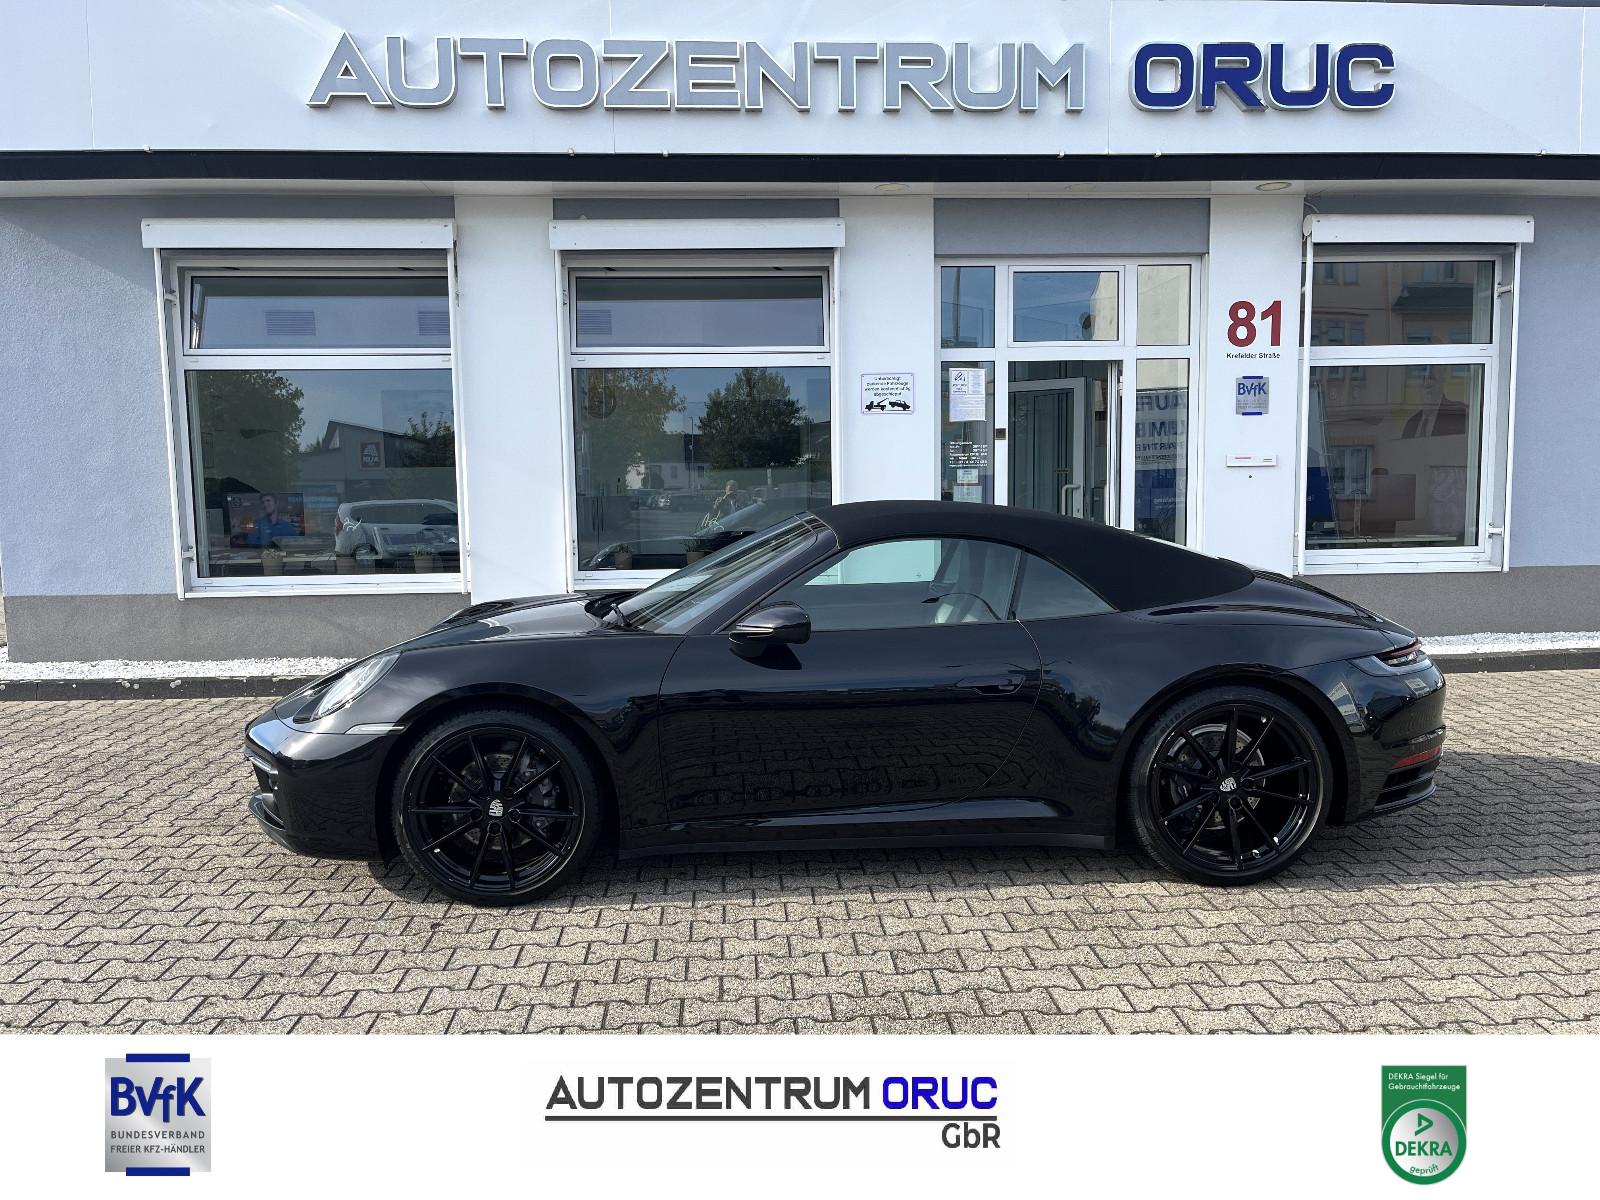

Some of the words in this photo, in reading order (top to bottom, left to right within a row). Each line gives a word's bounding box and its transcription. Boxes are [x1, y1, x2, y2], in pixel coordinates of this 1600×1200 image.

[306, 31, 1087, 112] AUTOZENTRUM
[1129, 42, 1396, 112] ORUC
[1227, 300, 1282, 347] 81
